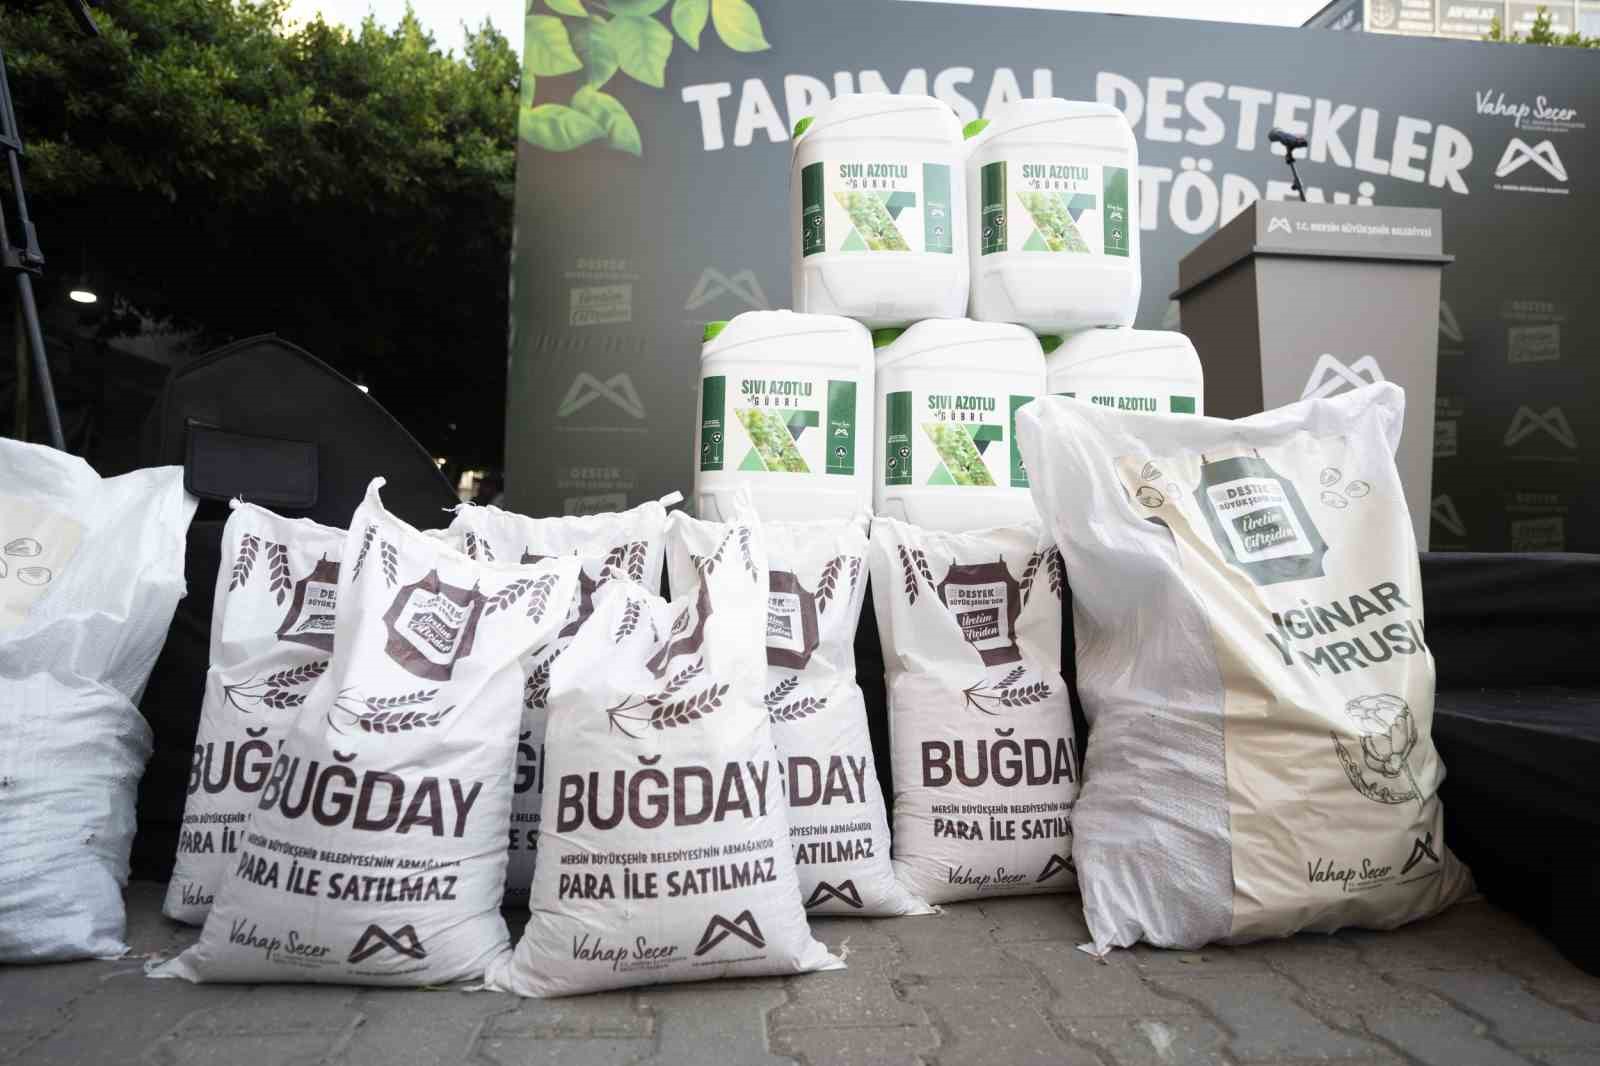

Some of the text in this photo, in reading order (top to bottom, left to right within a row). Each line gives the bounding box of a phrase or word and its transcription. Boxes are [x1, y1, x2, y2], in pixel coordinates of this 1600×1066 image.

[1476, 89, 1530, 128] Vahap
[1095, 71, 1474, 195] DESTEKLER
[840, 164, 908, 178] SIVI AZOTLU
[1022, 164, 1089, 180] SIVI AZOTLU
[741, 379, 812, 396] SIVI AZOTLU
[928, 394, 996, 411] SIVI AZOTLU
[1118, 397, 1158, 412] AZOTLU
[958, 588, 995, 599] DESTEK
[257, 748, 484, 838] BUĞDAY
[556, 754, 770, 833] BUĞDAY
[777, 754, 866, 807] DAY
[931, 804, 960, 815] MERSİN
[961, 802, 1008, 817] BÜYÜKŞEHİR
[1010, 801, 1058, 814] BELEDİYESİ'NİN
[180, 830, 214, 854] PARA
[933, 818, 984, 841] PARA
[989, 816, 1016, 841] İLE
[268, 835, 318, 860] BÜYÜKŞEHİR
[319, 850, 395, 869] BELEDİYESİ'NİN
[560, 852, 590, 866] MERSİN
[591, 851, 648, 867] BÜYÜKŞEHİR
[650, 846, 720, 864] BELEDİYESİ'NİN
[236, 851, 458, 902] PARA İLE SATILMAZ
[559, 856, 777, 900] PARA İLE SATILMAZ
[949, 865, 991, 890] Vahap
[1307, 857, 1357, 892] Vahap
[228, 917, 281, 960] Vahap
[572, 933, 628, 972] Vahap
